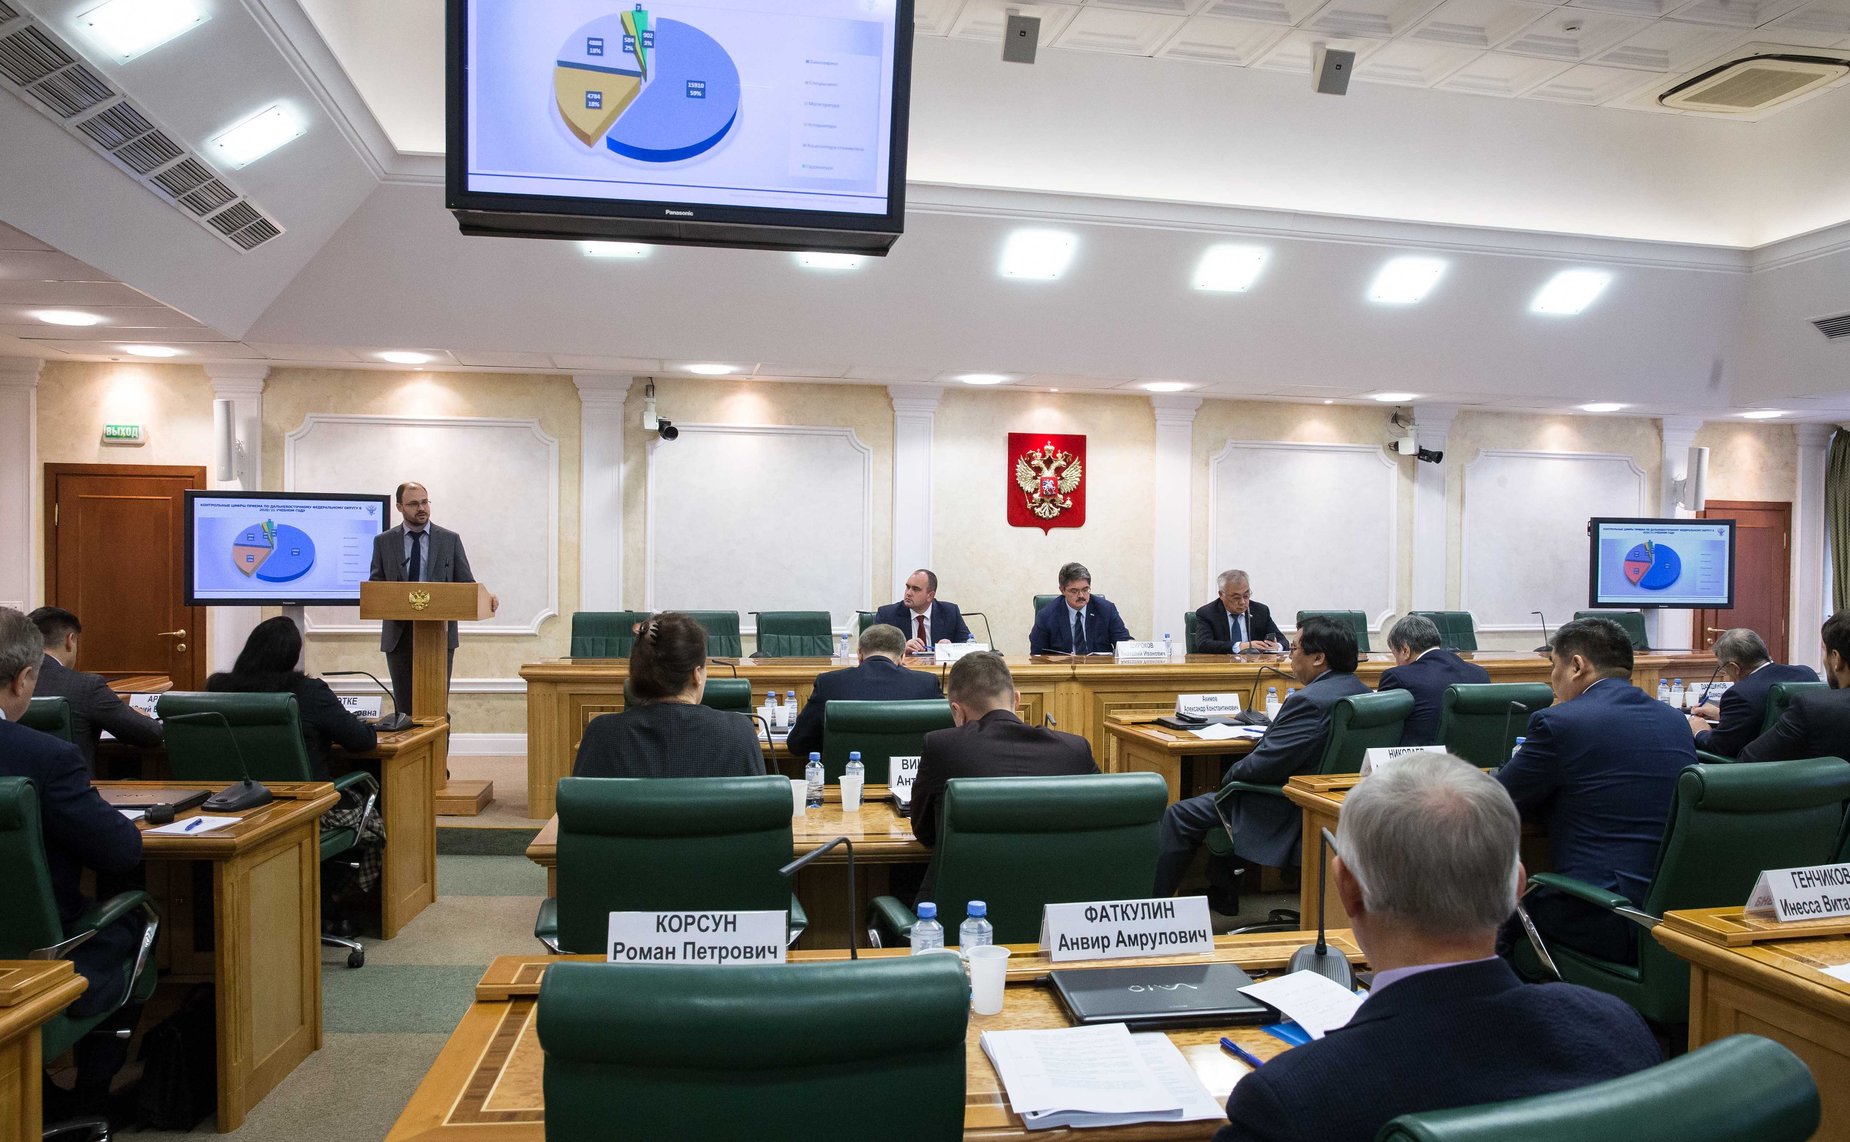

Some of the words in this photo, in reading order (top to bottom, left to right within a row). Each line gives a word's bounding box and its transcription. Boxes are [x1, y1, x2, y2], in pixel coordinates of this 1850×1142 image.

[665, 209, 694, 217] Panasonic
[106, 426, 139, 438] ВЫХОД
[1084, 901, 1175, 923] ФАТКУЛИН
[1779, 898, 1823, 917] Инесса
[1821, 894, 1850, 912] Вита
[656, 914, 737, 933] КОРСУН
[1058, 933, 1111, 953] Анвир
[1115, 929, 1208, 950] Амрулович
[613, 942, 676, 961] Роман
[683, 941, 778, 964] Петрович
